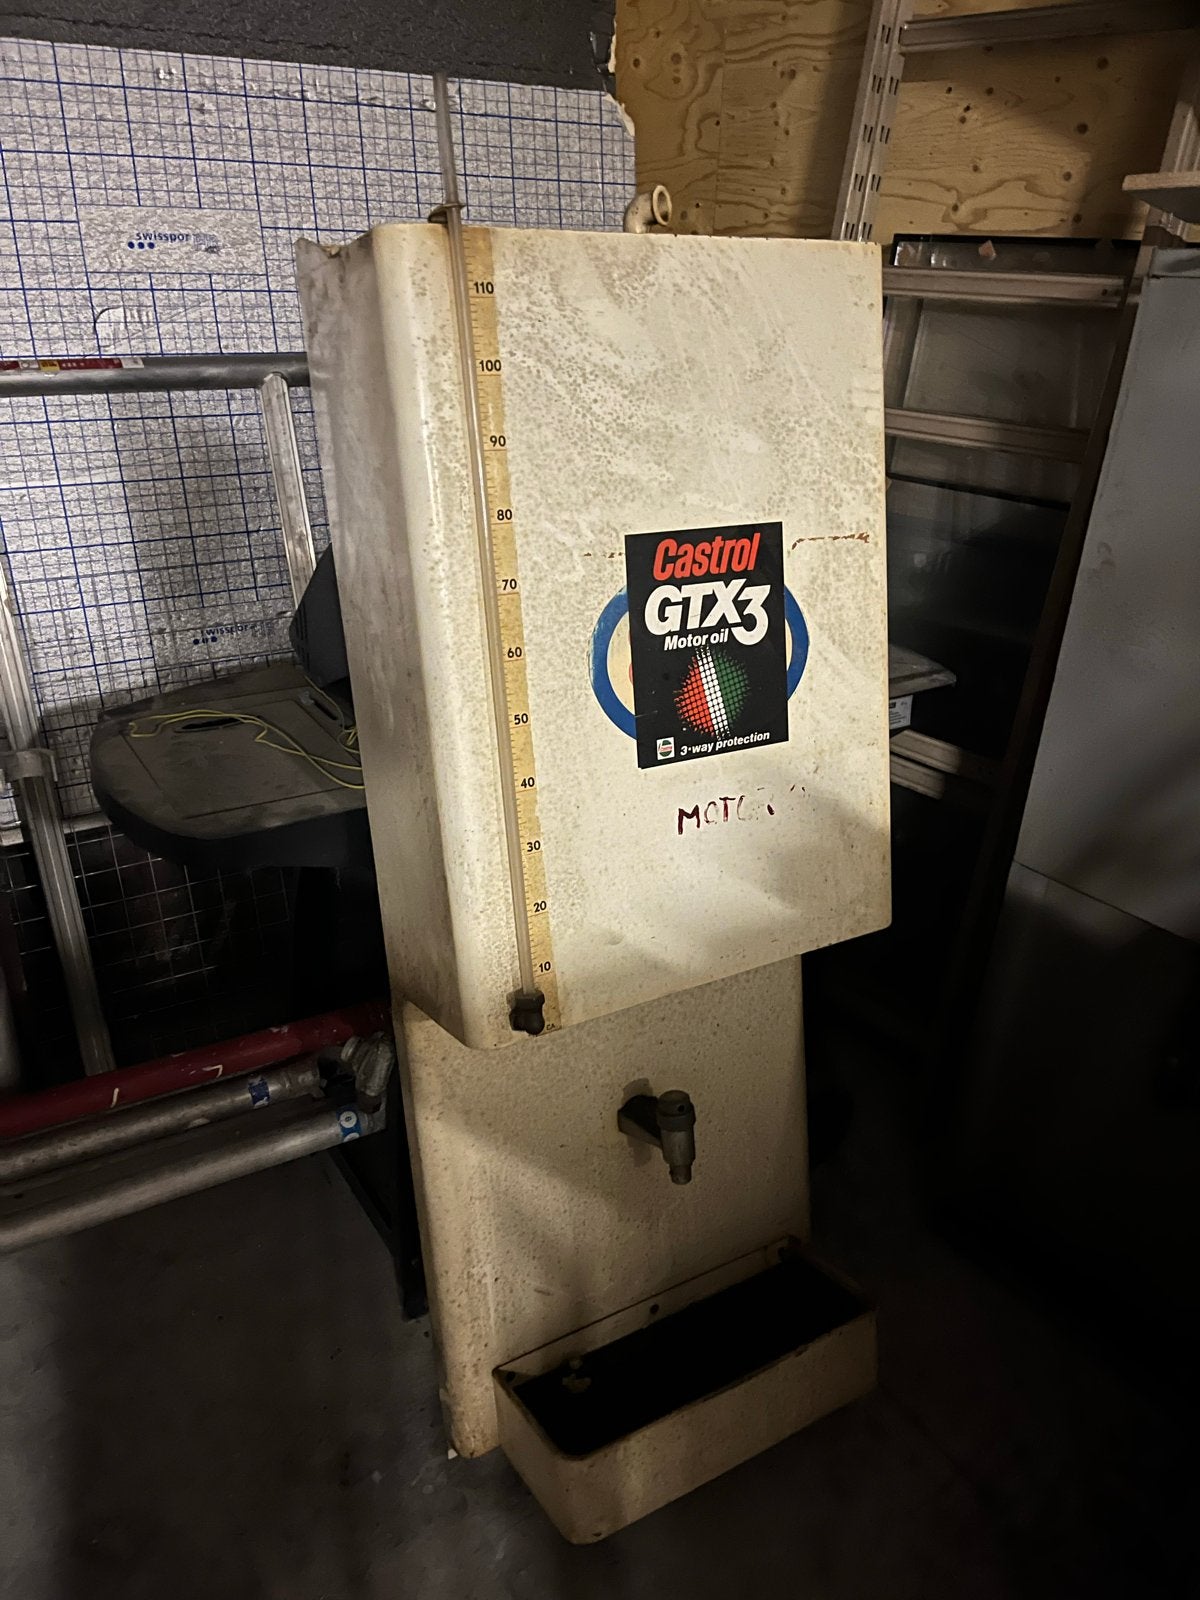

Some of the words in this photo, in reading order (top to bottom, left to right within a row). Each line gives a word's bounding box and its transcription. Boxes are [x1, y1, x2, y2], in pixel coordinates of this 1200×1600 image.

[136, 231, 190, 243] swisspor
[474, 281, 495, 295] 110
[478, 359, 502, 372] 100
[489, 435, 507, 447] 90
[496, 508, 513, 521] 80
[652, 532, 761, 581] Castrol
[501, 578, 518, 591] 70
[644, 578, 771, 646] GTX3
[663, 633, 710, 651] Motor
[710, 627, 729, 644] oil
[507, 646, 523, 659] 60
[513, 713, 529, 725] 50
[715, 731, 771, 751] protection
[520, 776, 535, 789] 40
[526, 840, 541, 853] 30
[533, 900, 548, 914] 20
[538, 961, 552, 974] 10
